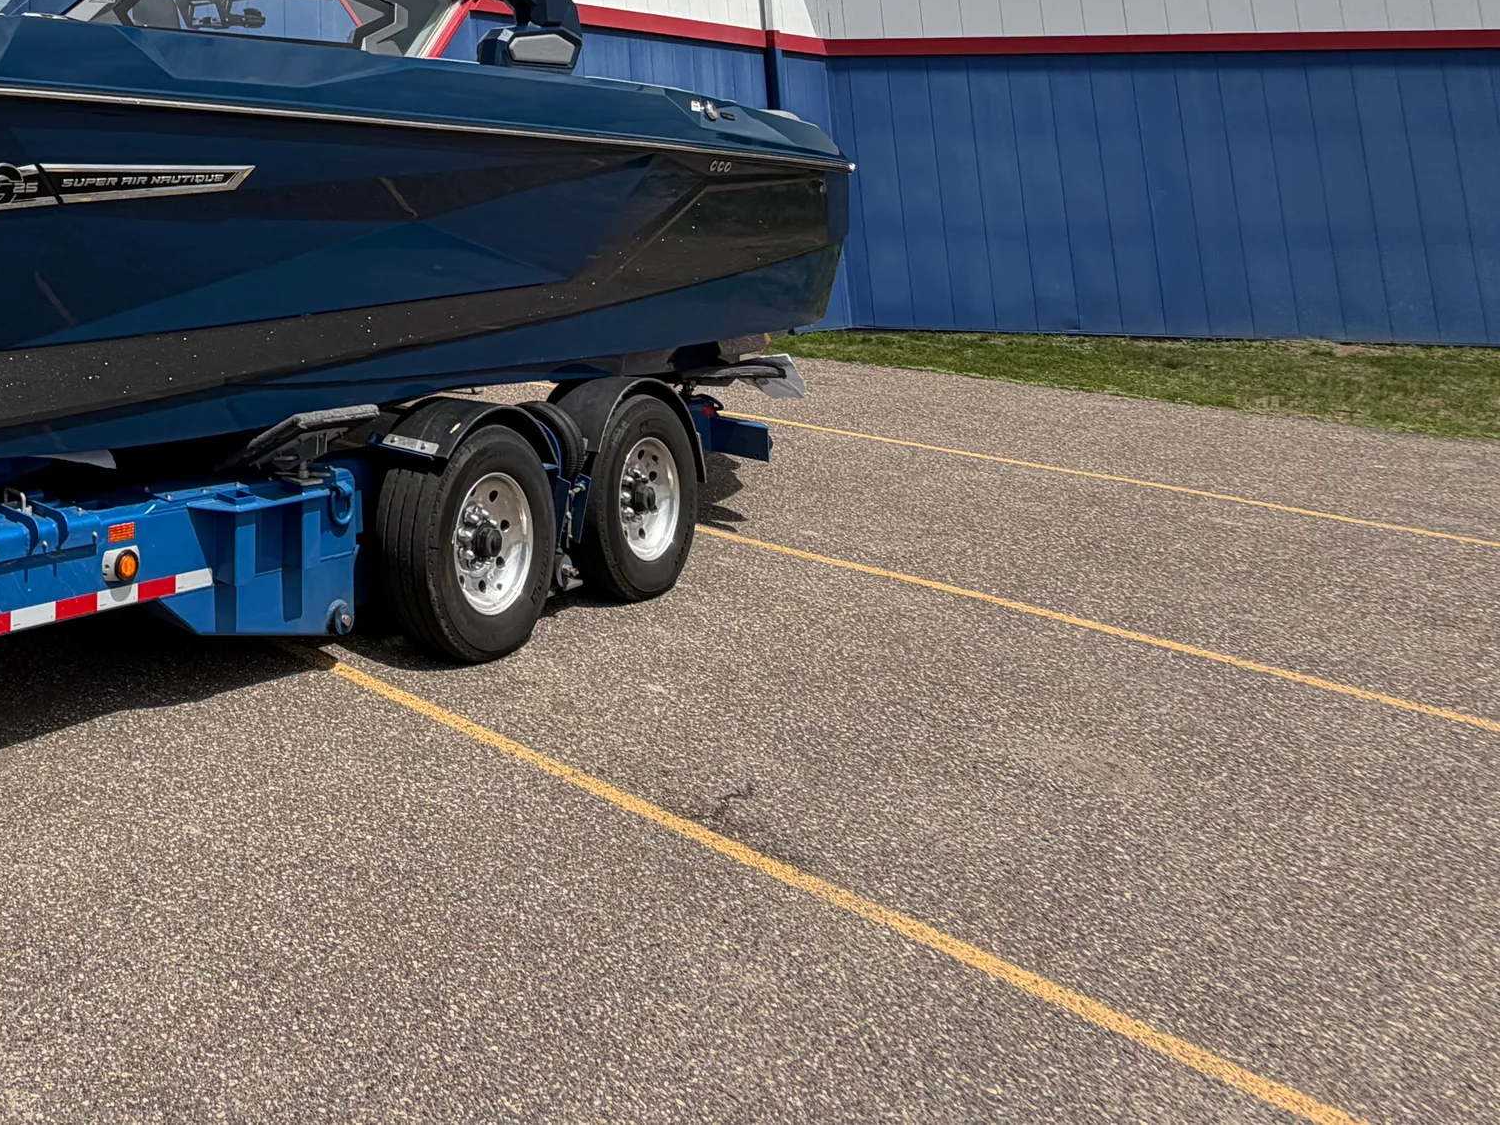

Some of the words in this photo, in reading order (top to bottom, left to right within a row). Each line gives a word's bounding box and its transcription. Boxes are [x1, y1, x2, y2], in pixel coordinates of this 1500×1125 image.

[60, 177, 119, 188] SUPER
[120, 175, 149, 186] AIR
[150, 173, 225, 185] NAUTIQUE
